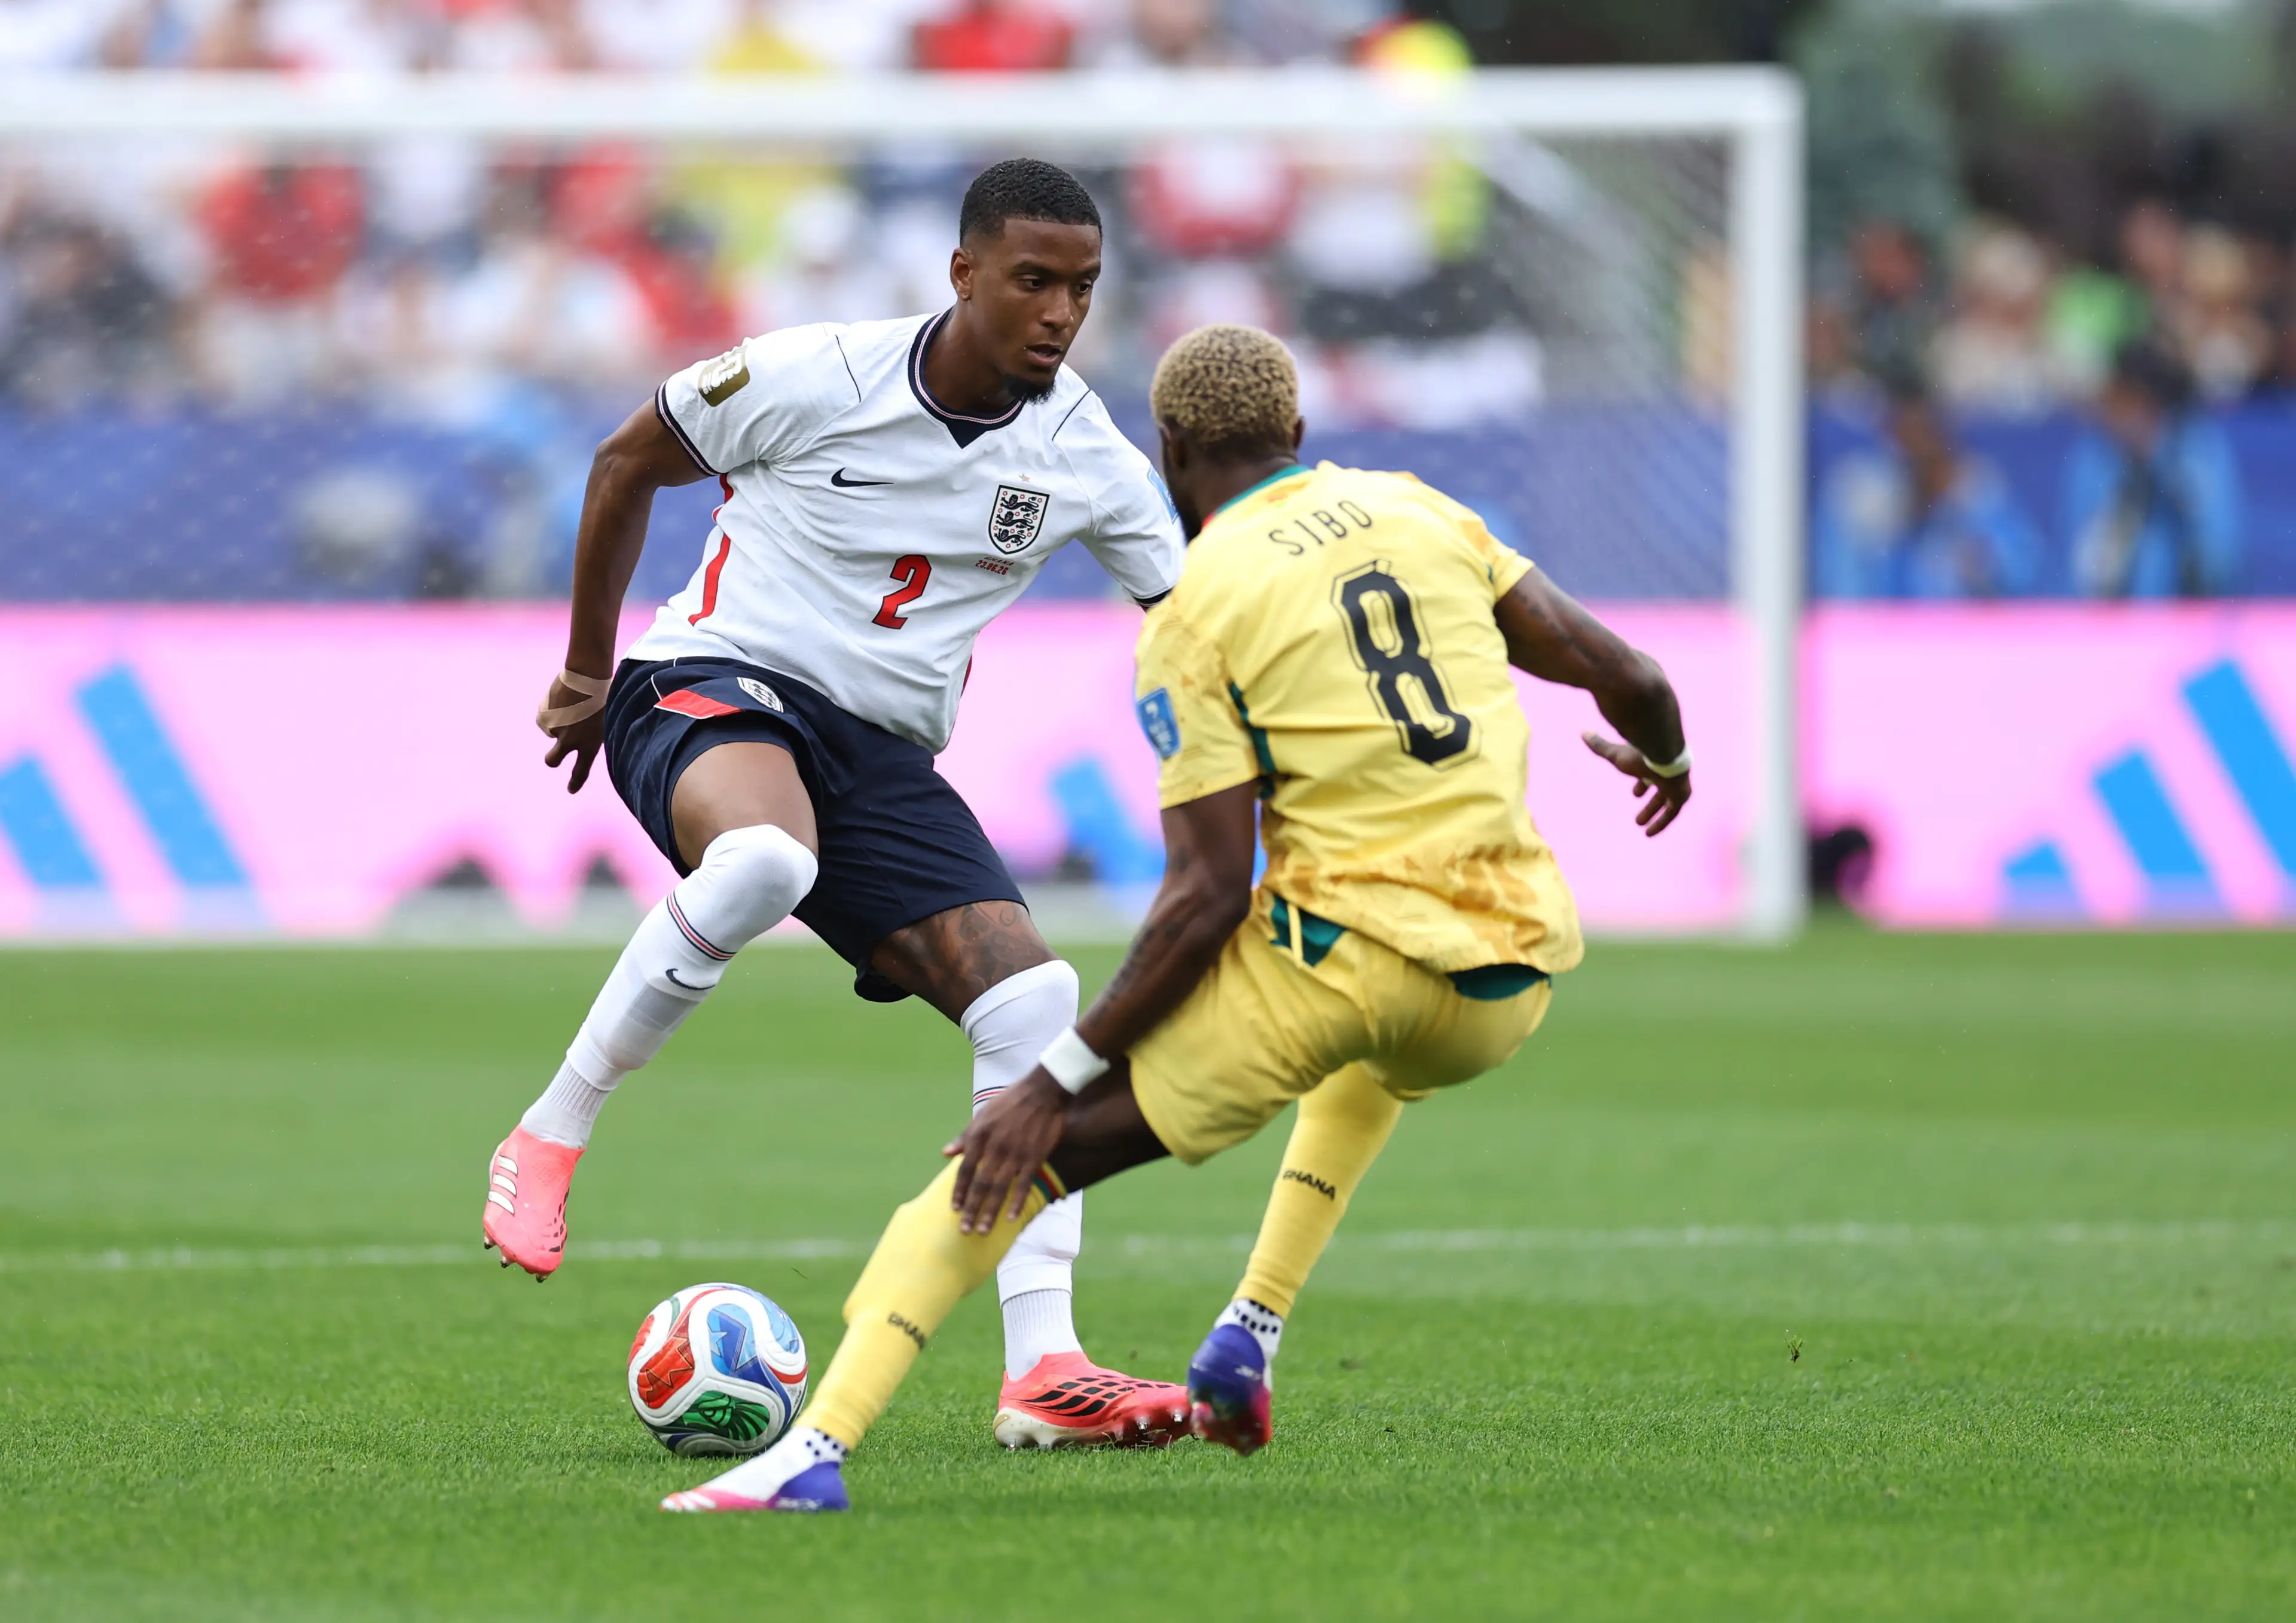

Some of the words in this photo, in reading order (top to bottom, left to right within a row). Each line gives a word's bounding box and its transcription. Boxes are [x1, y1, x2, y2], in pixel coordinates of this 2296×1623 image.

[1269, 500, 1372, 556] SIBO
[872, 554, 932, 629] 2
[975, 560, 1009, 575] 23.06.26
[1330, 558, 1483, 772] 8
[1283, 1169, 1336, 1201] GHANA
